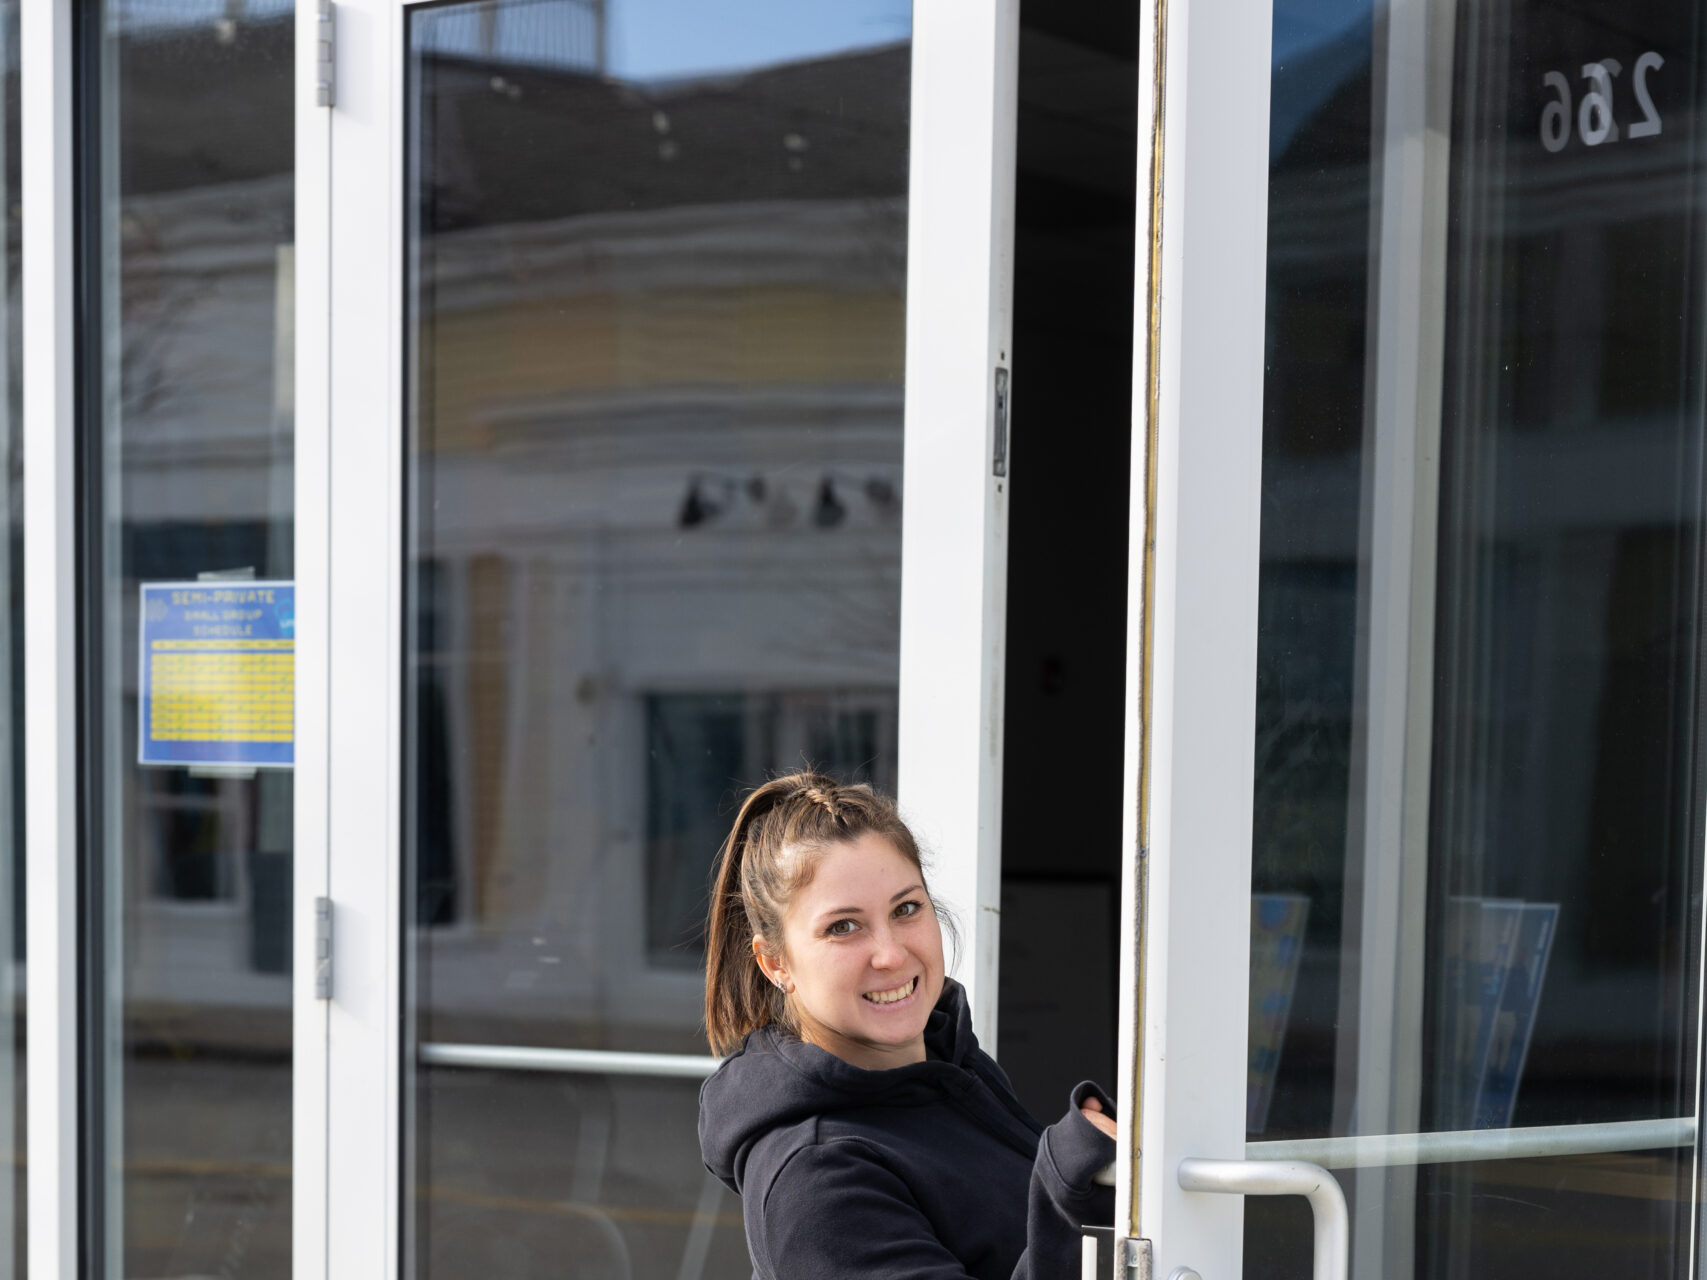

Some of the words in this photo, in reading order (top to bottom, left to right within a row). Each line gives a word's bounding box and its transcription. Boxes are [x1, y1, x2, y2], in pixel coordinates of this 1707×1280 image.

[171, 590, 275, 605] SEMI-PRIVATE
[184, 610, 220, 621] SMALL
[222, 609, 263, 621] GROUP
[193, 625, 253, 636] SCHEDULE
